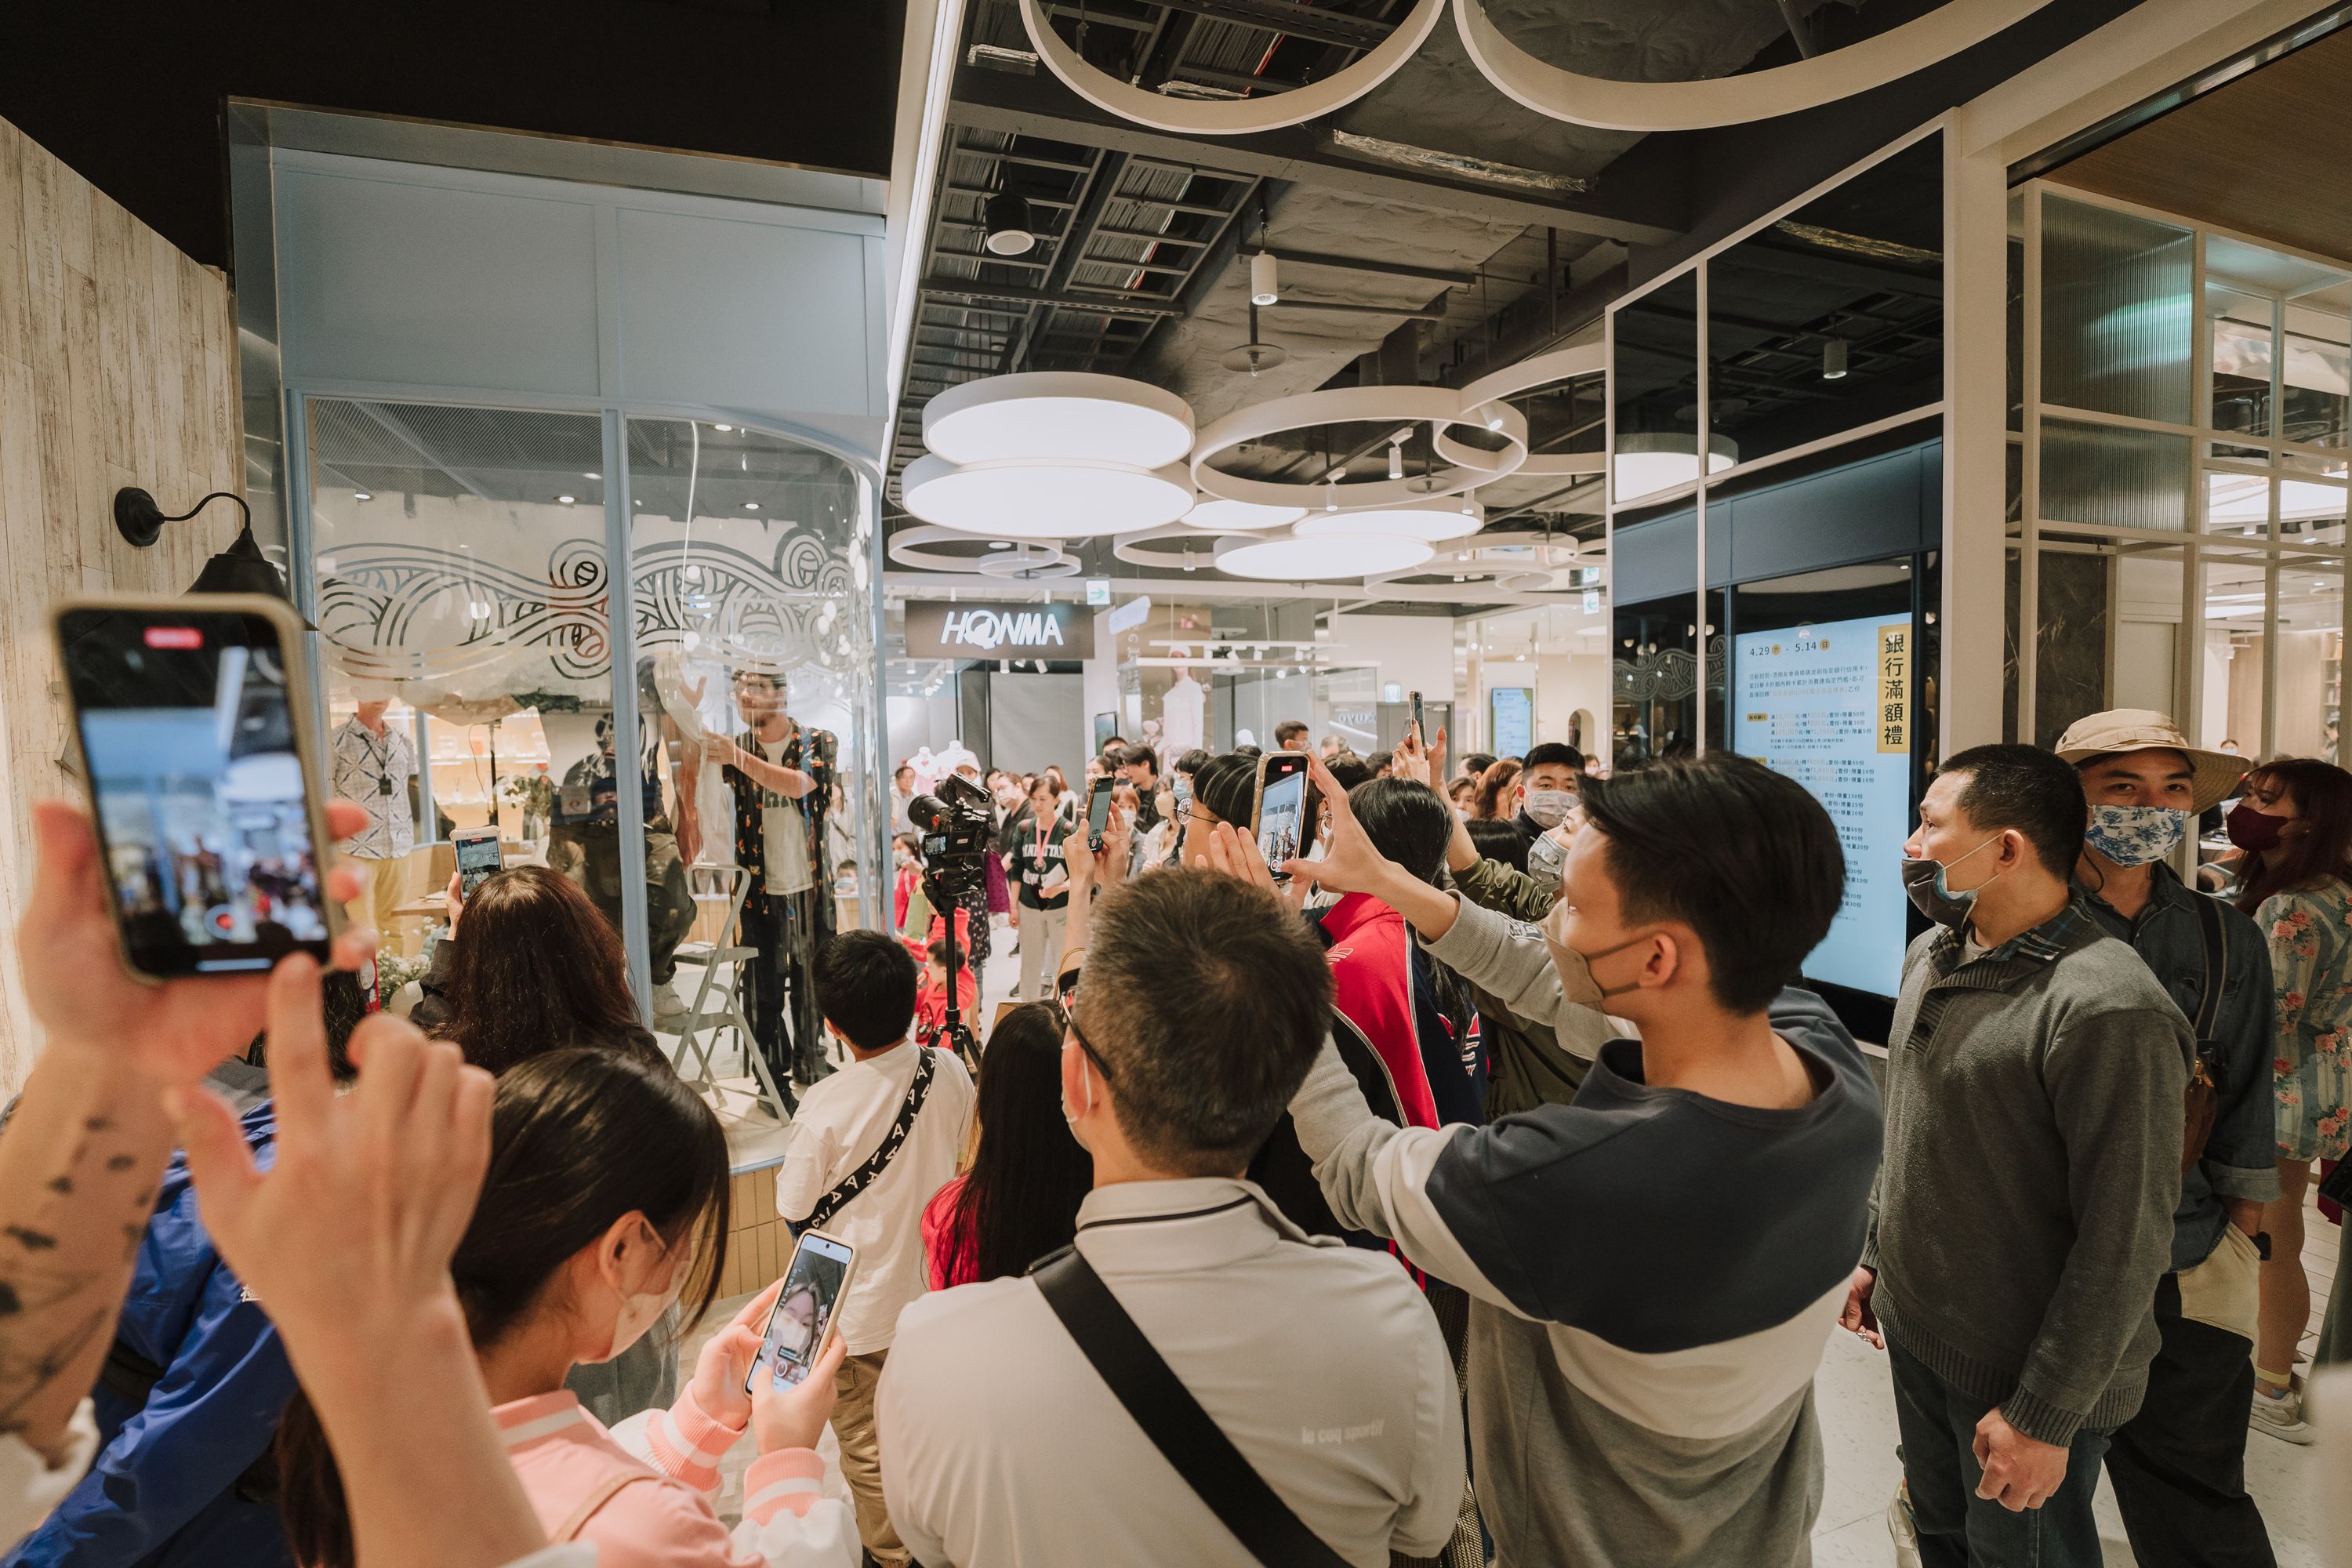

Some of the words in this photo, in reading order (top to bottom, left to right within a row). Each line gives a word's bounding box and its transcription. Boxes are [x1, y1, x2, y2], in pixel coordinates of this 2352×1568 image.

[941, 610, 1064, 650] HONMA
[1750, 647, 1769, 656] 4.29
[1795, 642, 1817, 652] 5.14
[1885, 633, 1904, 745] 銀行滿額禮
